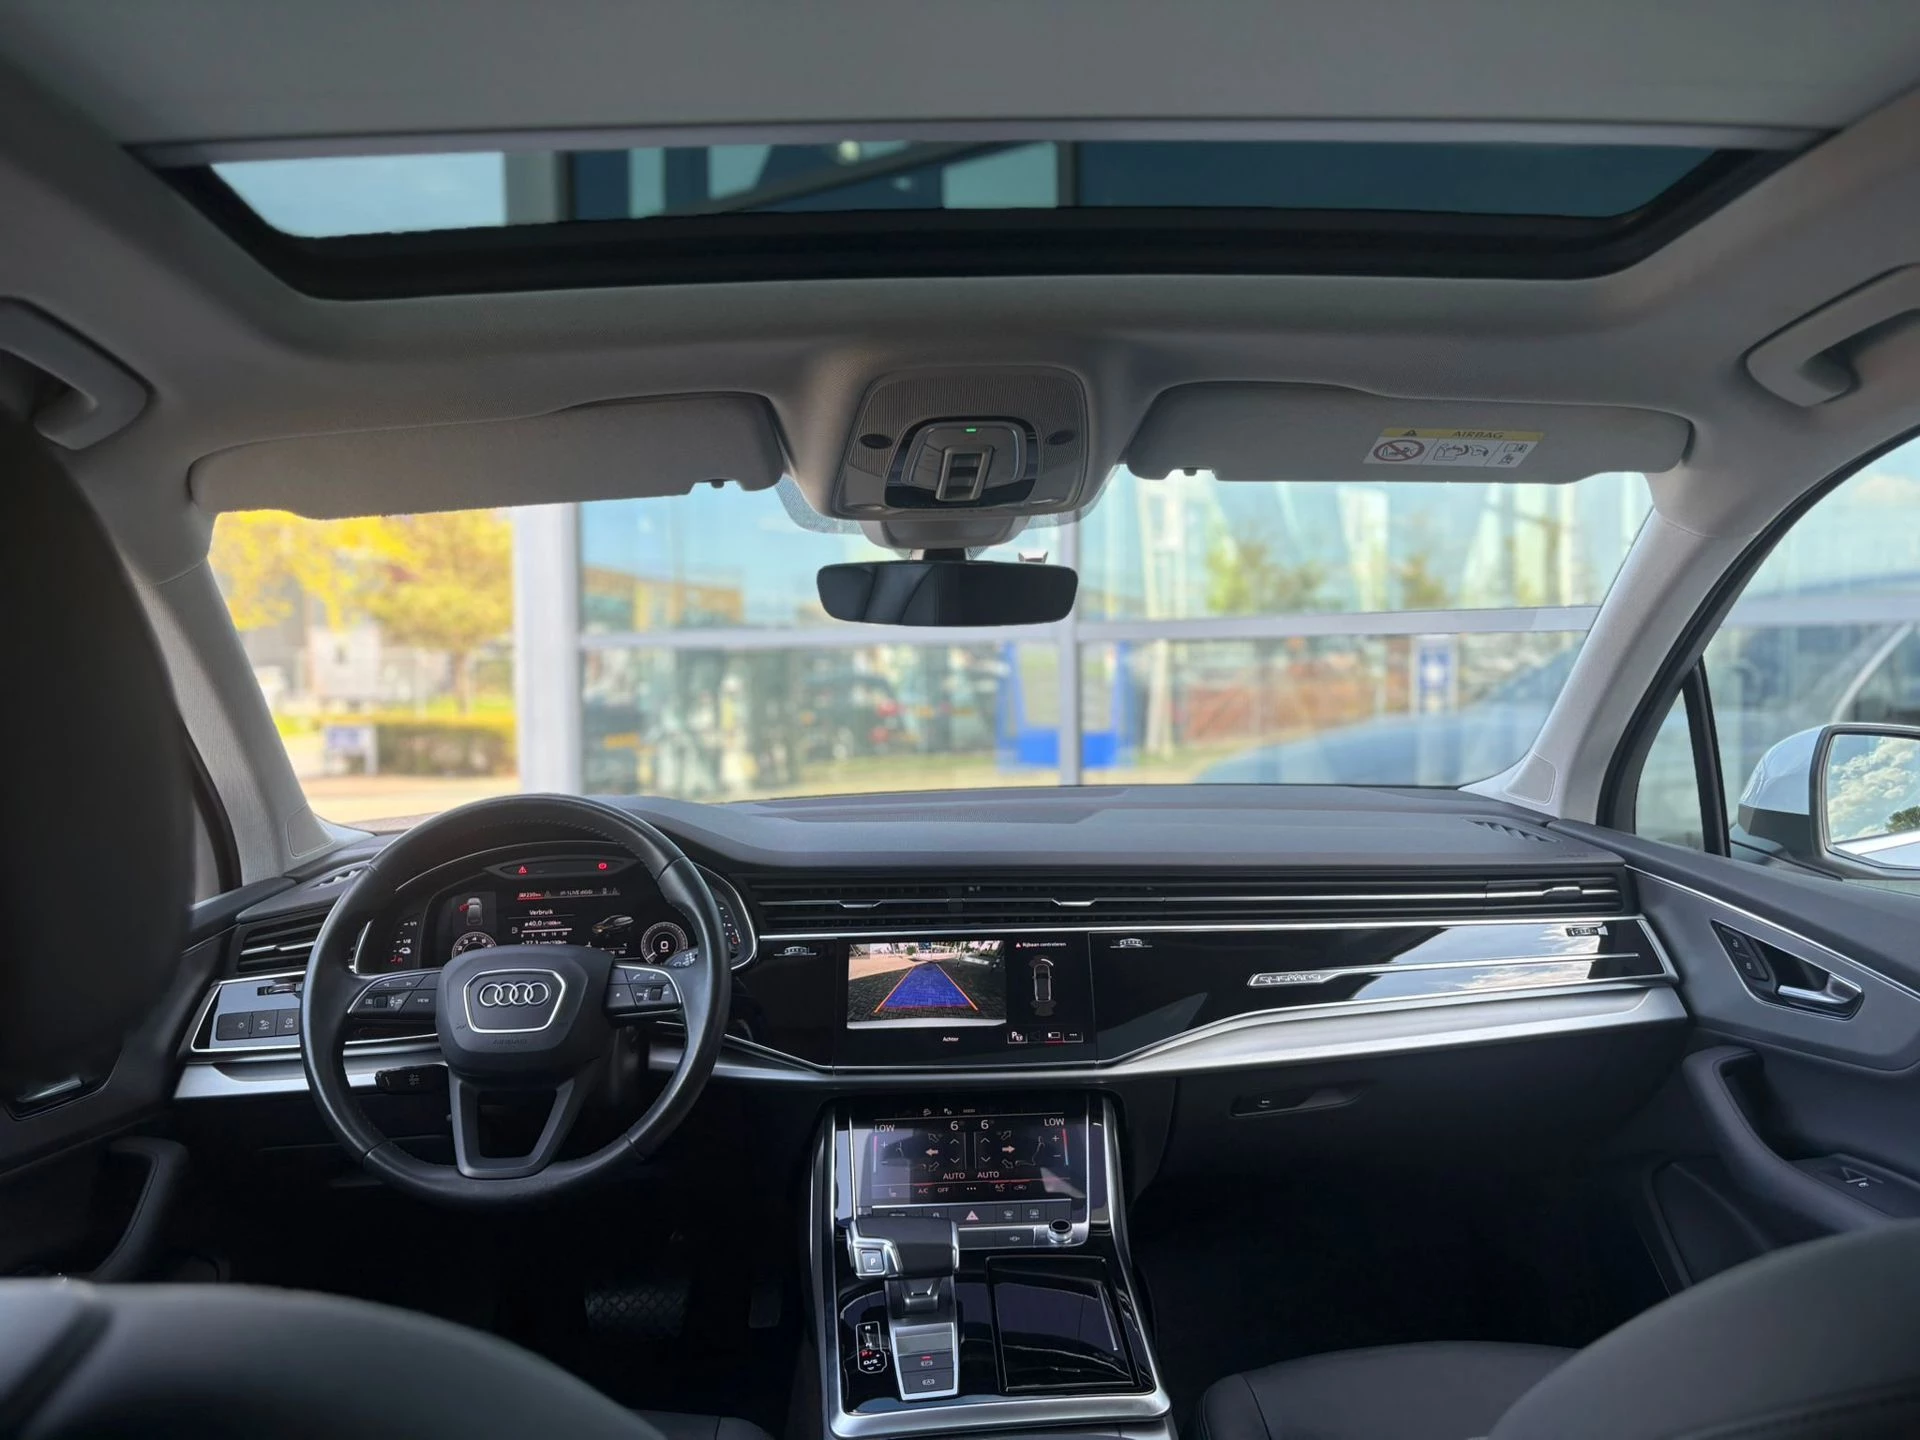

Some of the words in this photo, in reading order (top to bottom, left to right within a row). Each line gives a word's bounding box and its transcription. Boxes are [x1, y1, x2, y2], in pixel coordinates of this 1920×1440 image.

[1452, 431, 1504, 439] AIRBAG
[660, 941, 669, 949] 0
[874, 1124, 895, 1133] LOW
[950, 1120, 959, 1131] 6
[981, 1119, 989, 1130] 6
[1044, 1117, 1065, 1127] LOW
[943, 1172, 965, 1180] AUTO
[977, 1171, 1000, 1179] AUTO
[870, 1257, 876, 1266] P
